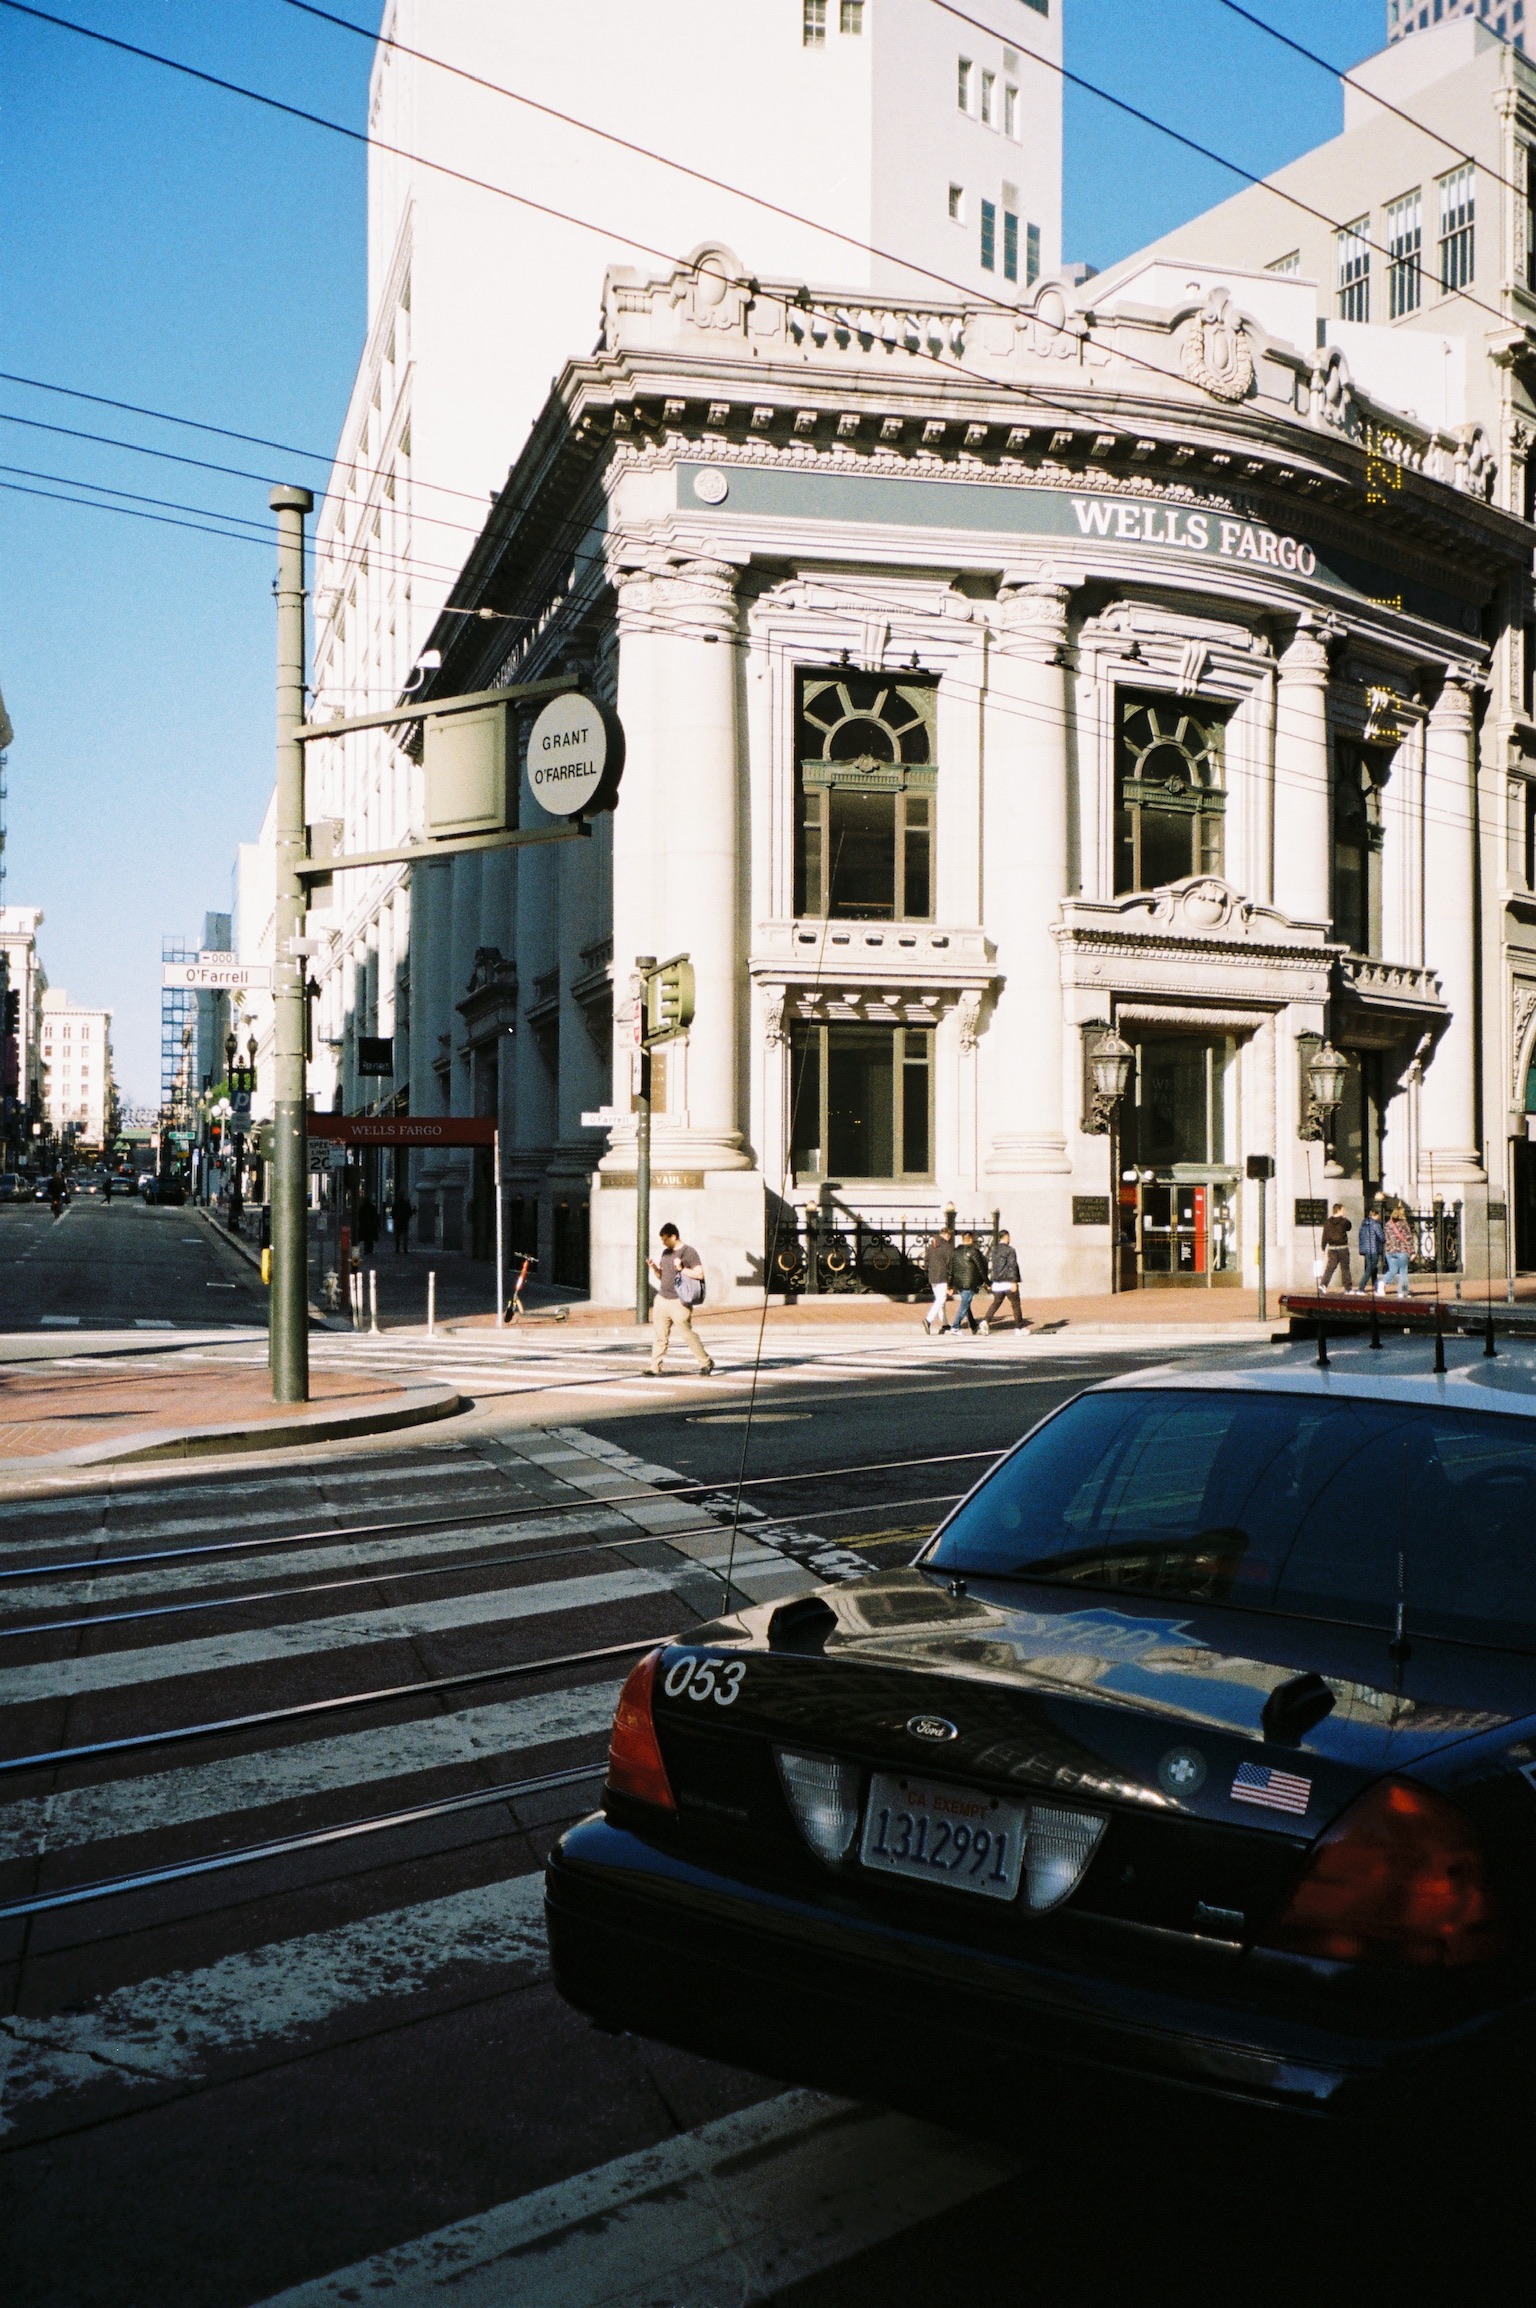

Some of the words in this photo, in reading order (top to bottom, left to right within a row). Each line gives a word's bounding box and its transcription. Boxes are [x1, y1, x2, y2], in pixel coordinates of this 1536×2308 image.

[1071, 499, 1209, 549] WELLS
[1219, 520, 1317, 577] FARGO
[542, 728, 589, 751] GRANT
[534, 760, 597, 785] O'FARRELL
[186, 968, 248, 983] O'Farrell
[351, 1125, 396, 1136] WELLS
[399, 1125, 443, 1136] FARGO
[664, 1655, 747, 1706] 053
[916, 1720, 944, 1738] Ford
[907, 1791, 926, 1808] CA
[932, 1796, 988, 1819] EXEMPT
[871, 1807, 1008, 1883] 1312991
